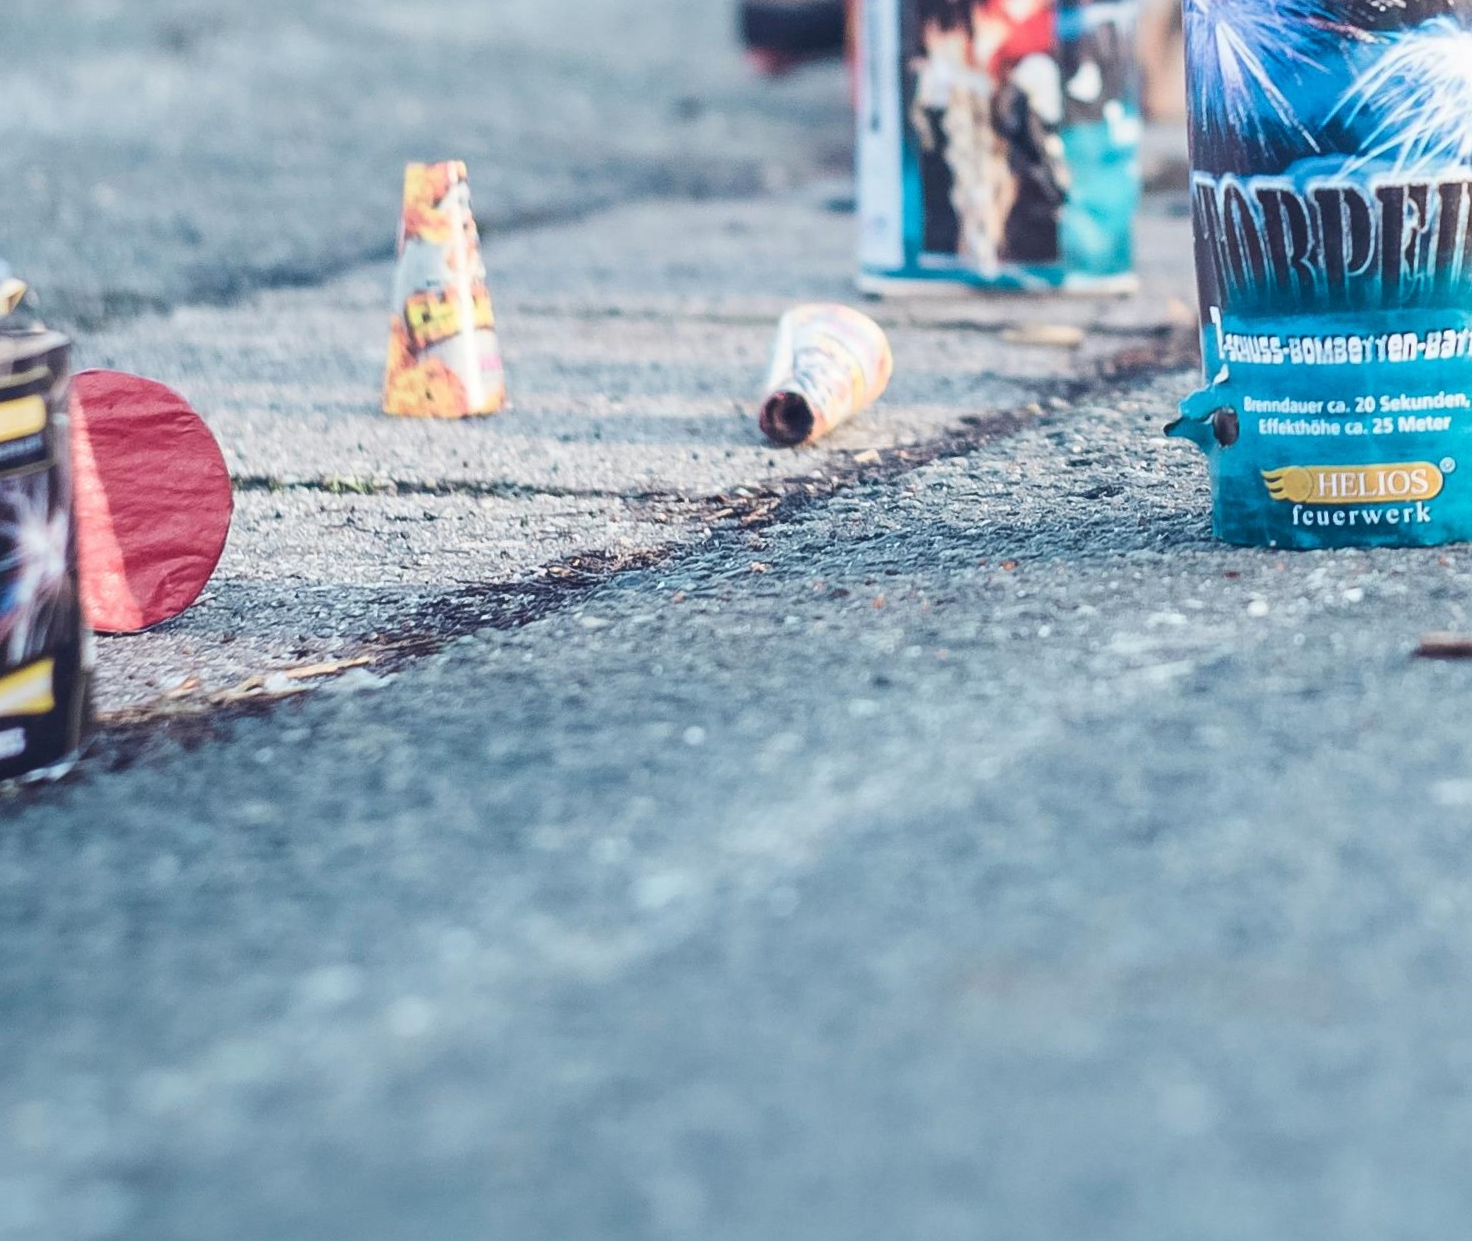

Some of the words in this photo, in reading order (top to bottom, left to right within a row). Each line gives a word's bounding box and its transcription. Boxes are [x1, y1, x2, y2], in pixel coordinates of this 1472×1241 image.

[1243, 395, 1323, 414] Brenndauer
[1327, 398, 1350, 414] ca.
[1354, 395, 1376, 414] 20
[1379, 390, 1471, 413] Sekunden,
[1258, 418, 1341, 436] Effekthöhe
[1344, 420, 1368, 436] ca.
[1372, 417, 1394, 435] 25
[1397, 414, 1452, 434] Meter
[1317, 468, 1429, 498] HELIOS
[1292, 502, 1432, 526] feuerwerk
